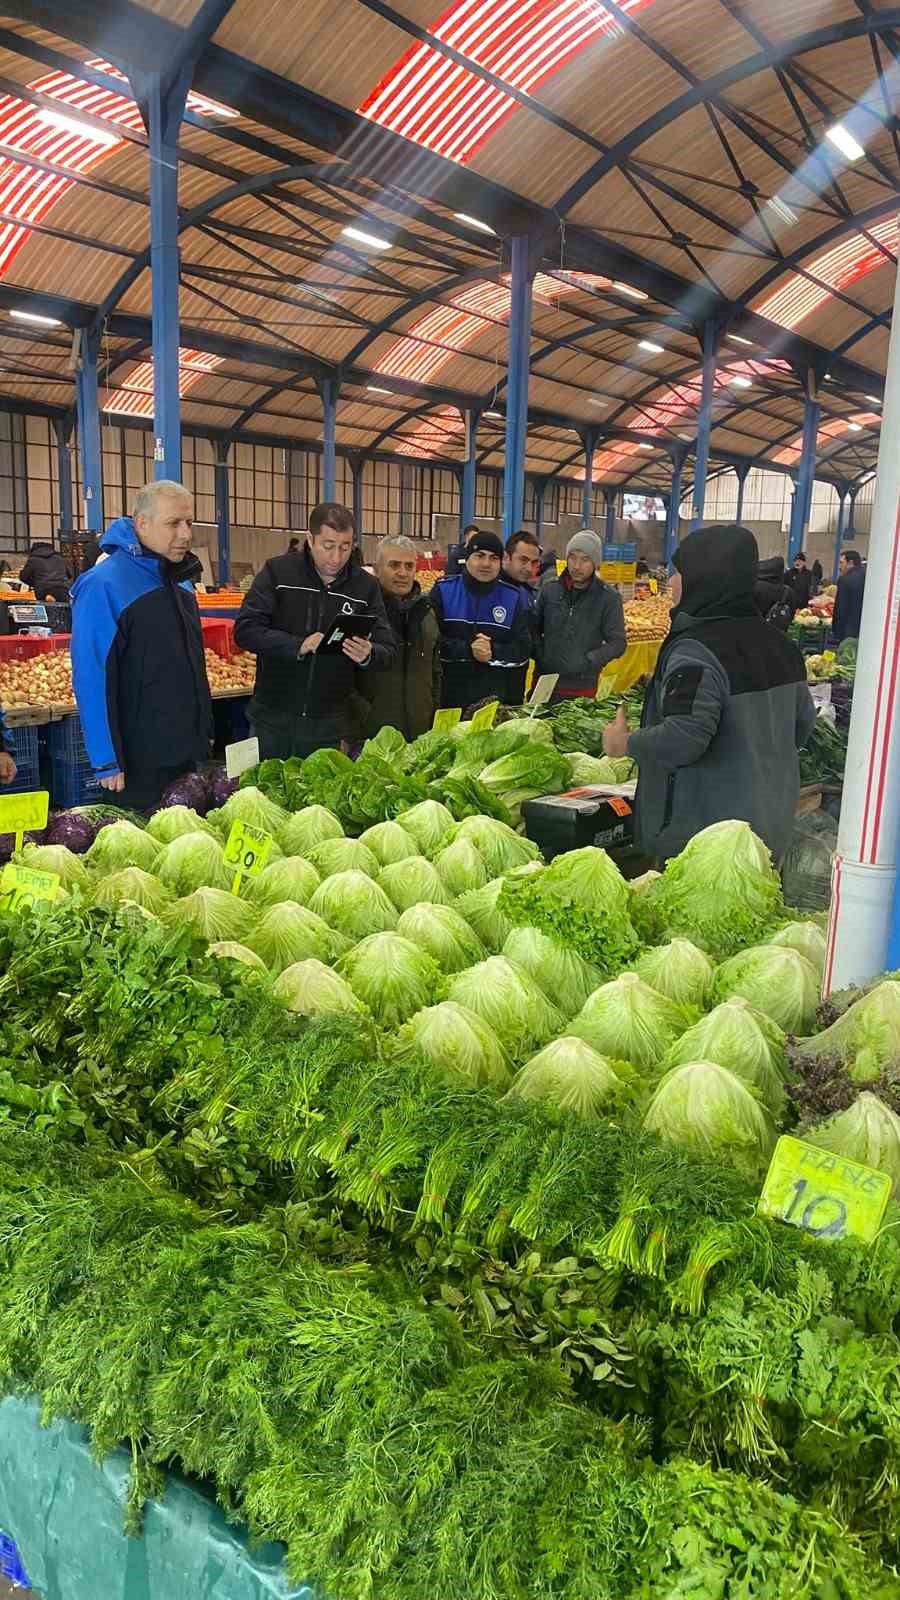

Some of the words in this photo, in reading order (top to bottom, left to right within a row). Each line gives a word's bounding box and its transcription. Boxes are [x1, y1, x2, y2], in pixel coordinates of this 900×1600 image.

[227, 838, 255, 868] 30
[800, 1147, 886, 1193] TANE
[784, 1179, 847, 1237] 10
